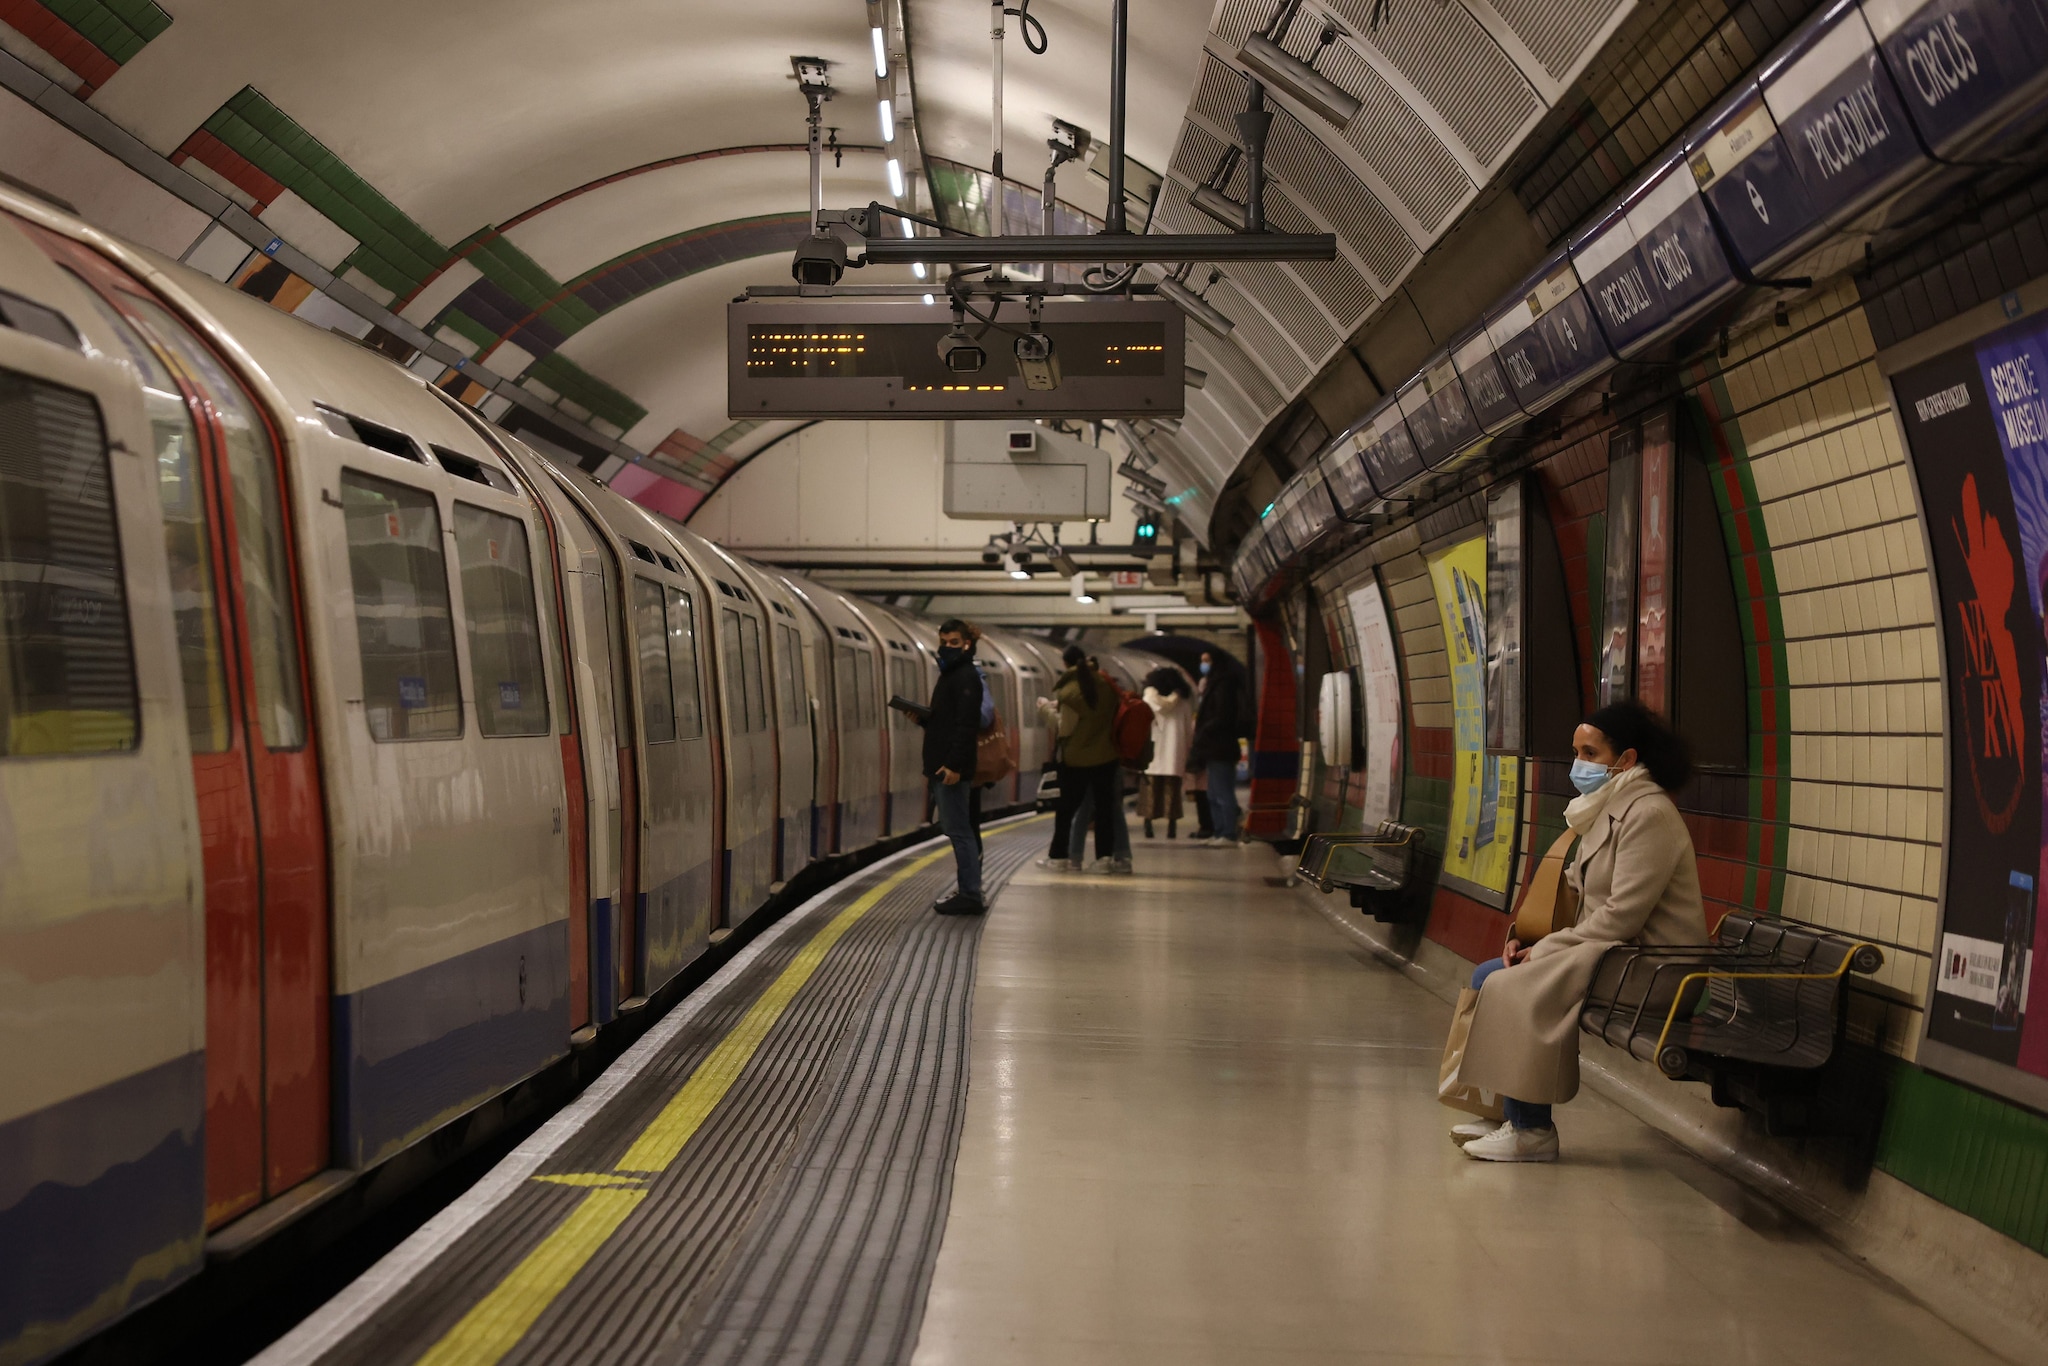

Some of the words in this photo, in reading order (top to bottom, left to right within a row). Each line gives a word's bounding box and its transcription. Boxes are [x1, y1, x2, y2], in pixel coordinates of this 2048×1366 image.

[1803, 76, 1891, 180] PICCADILLY
[1905, 12, 1978, 108] CIRCUS
[1600, 265, 1653, 327] PICCADILLY
[1652, 232, 1692, 291] CIRCUS
[1507, 347, 1537, 389] CIRCUS
[1990, 353, 2040, 407] SCIENCE
